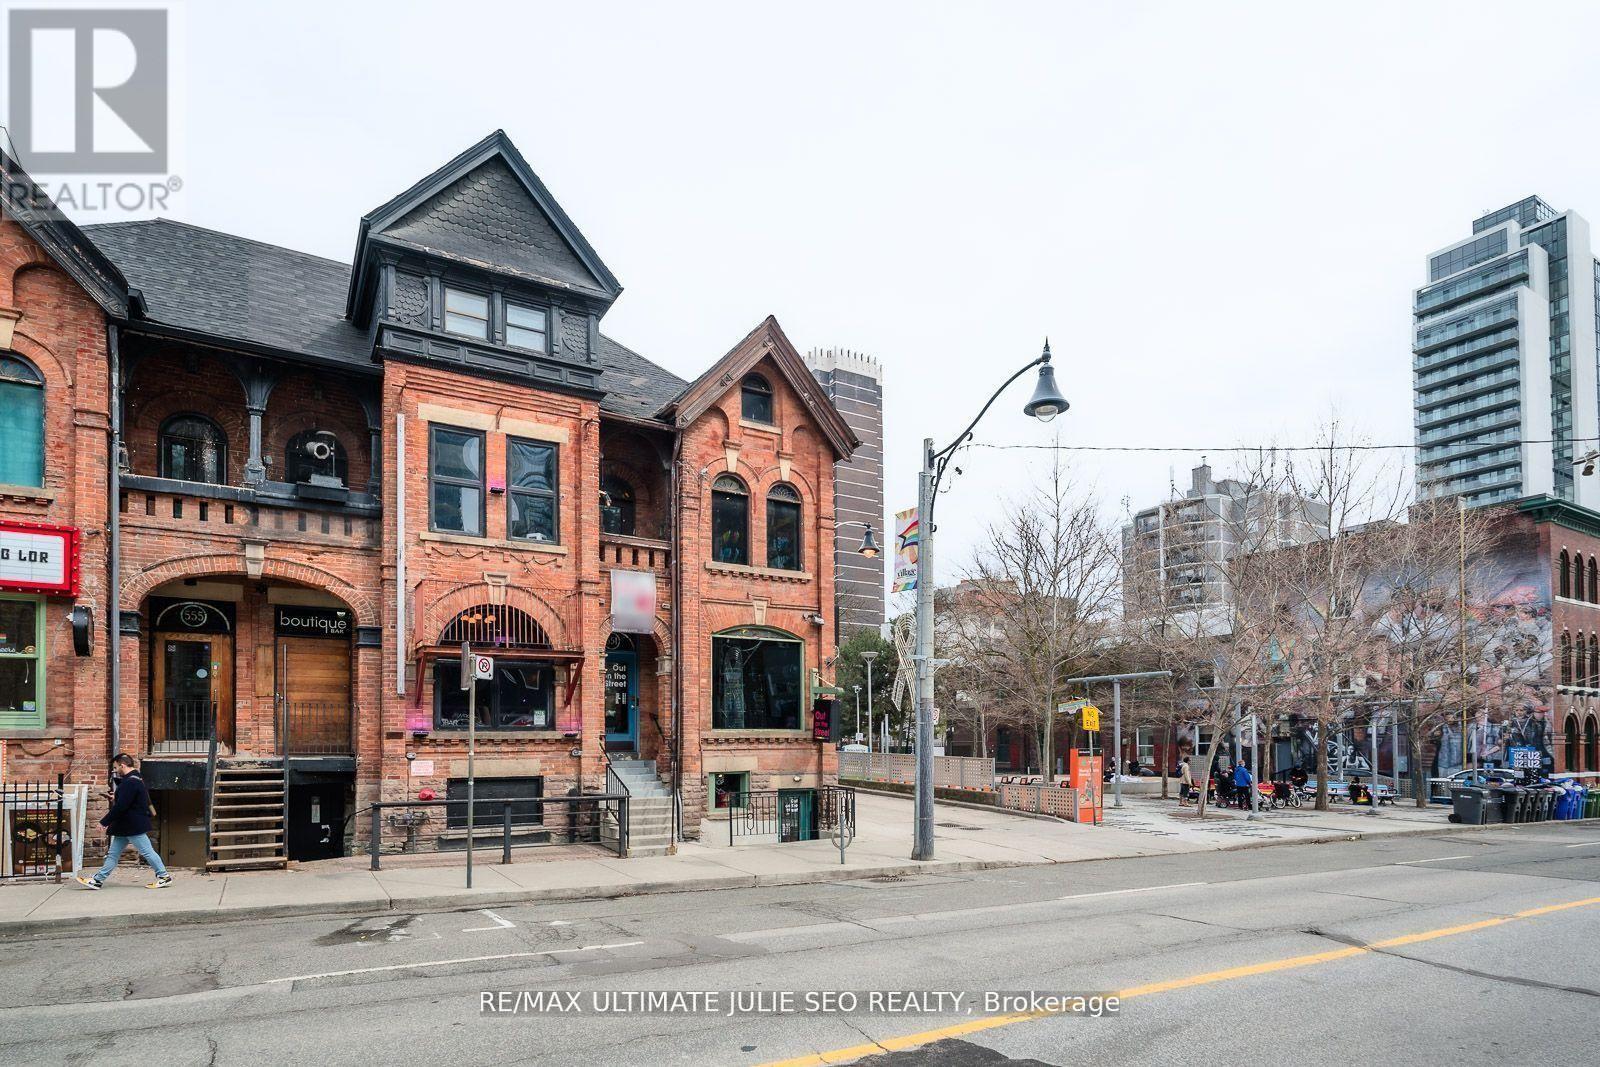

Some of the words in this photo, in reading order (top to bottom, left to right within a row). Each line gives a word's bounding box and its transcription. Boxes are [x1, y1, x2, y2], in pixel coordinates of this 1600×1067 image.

[19, 550, 48, 563] LOR
[183, 610, 204, 622] 555
[280, 610, 347, 634] boutique
[613, 663, 626, 672] Out
[614, 672, 627, 680] the
[815, 711, 826, 720] Out
